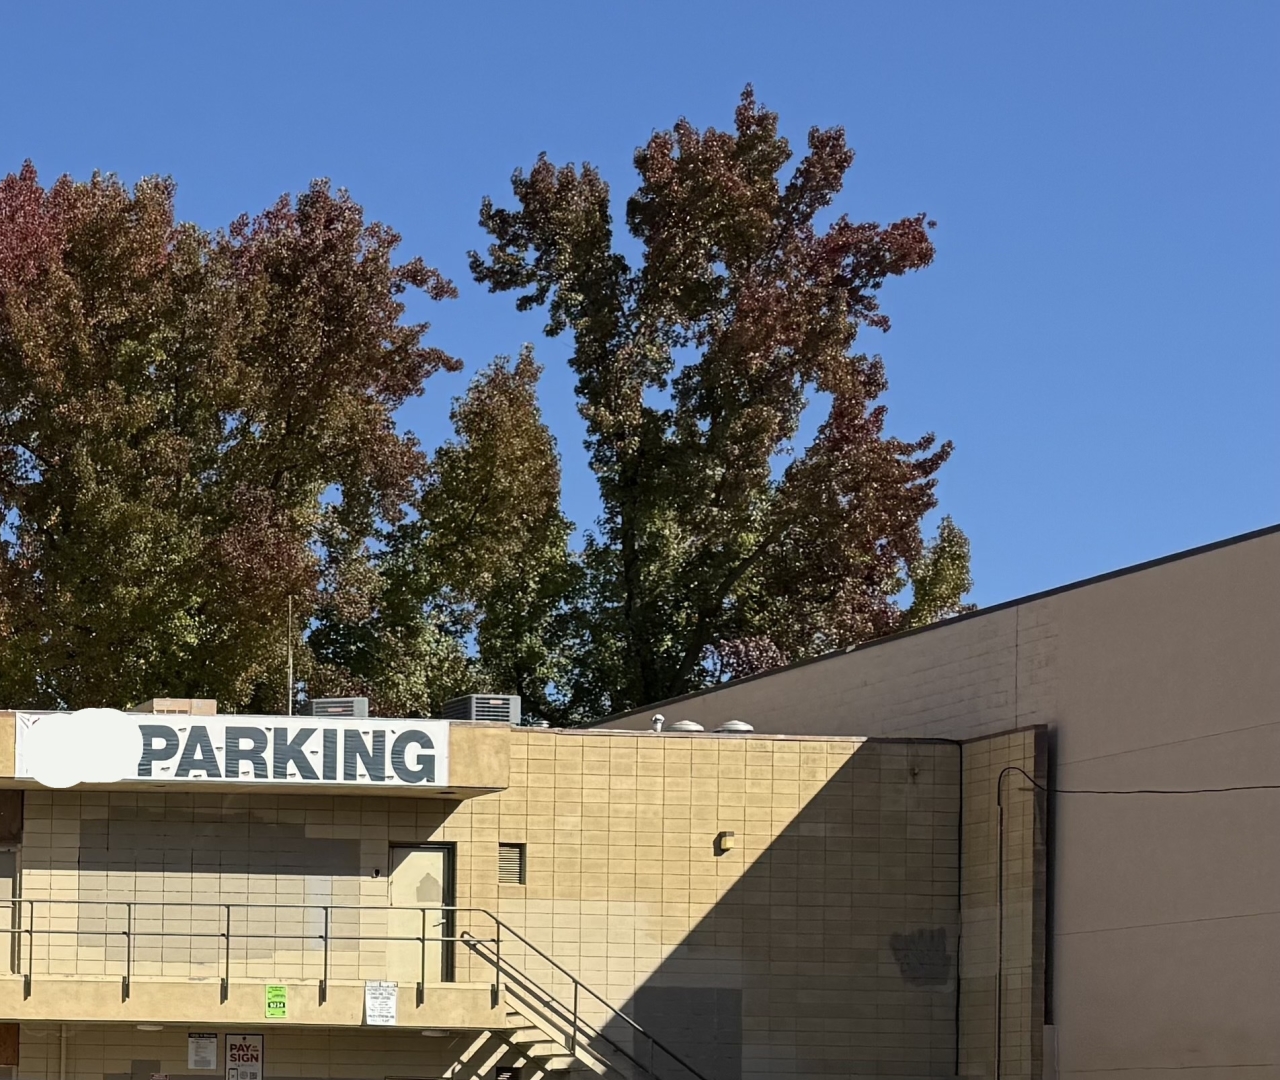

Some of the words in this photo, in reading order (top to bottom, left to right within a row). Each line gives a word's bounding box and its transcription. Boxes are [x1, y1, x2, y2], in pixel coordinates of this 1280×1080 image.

[137, 724, 437, 784] PARKING
[230, 1043, 251, 1052] PAY
[230, 1053, 259, 1062] SIGN
